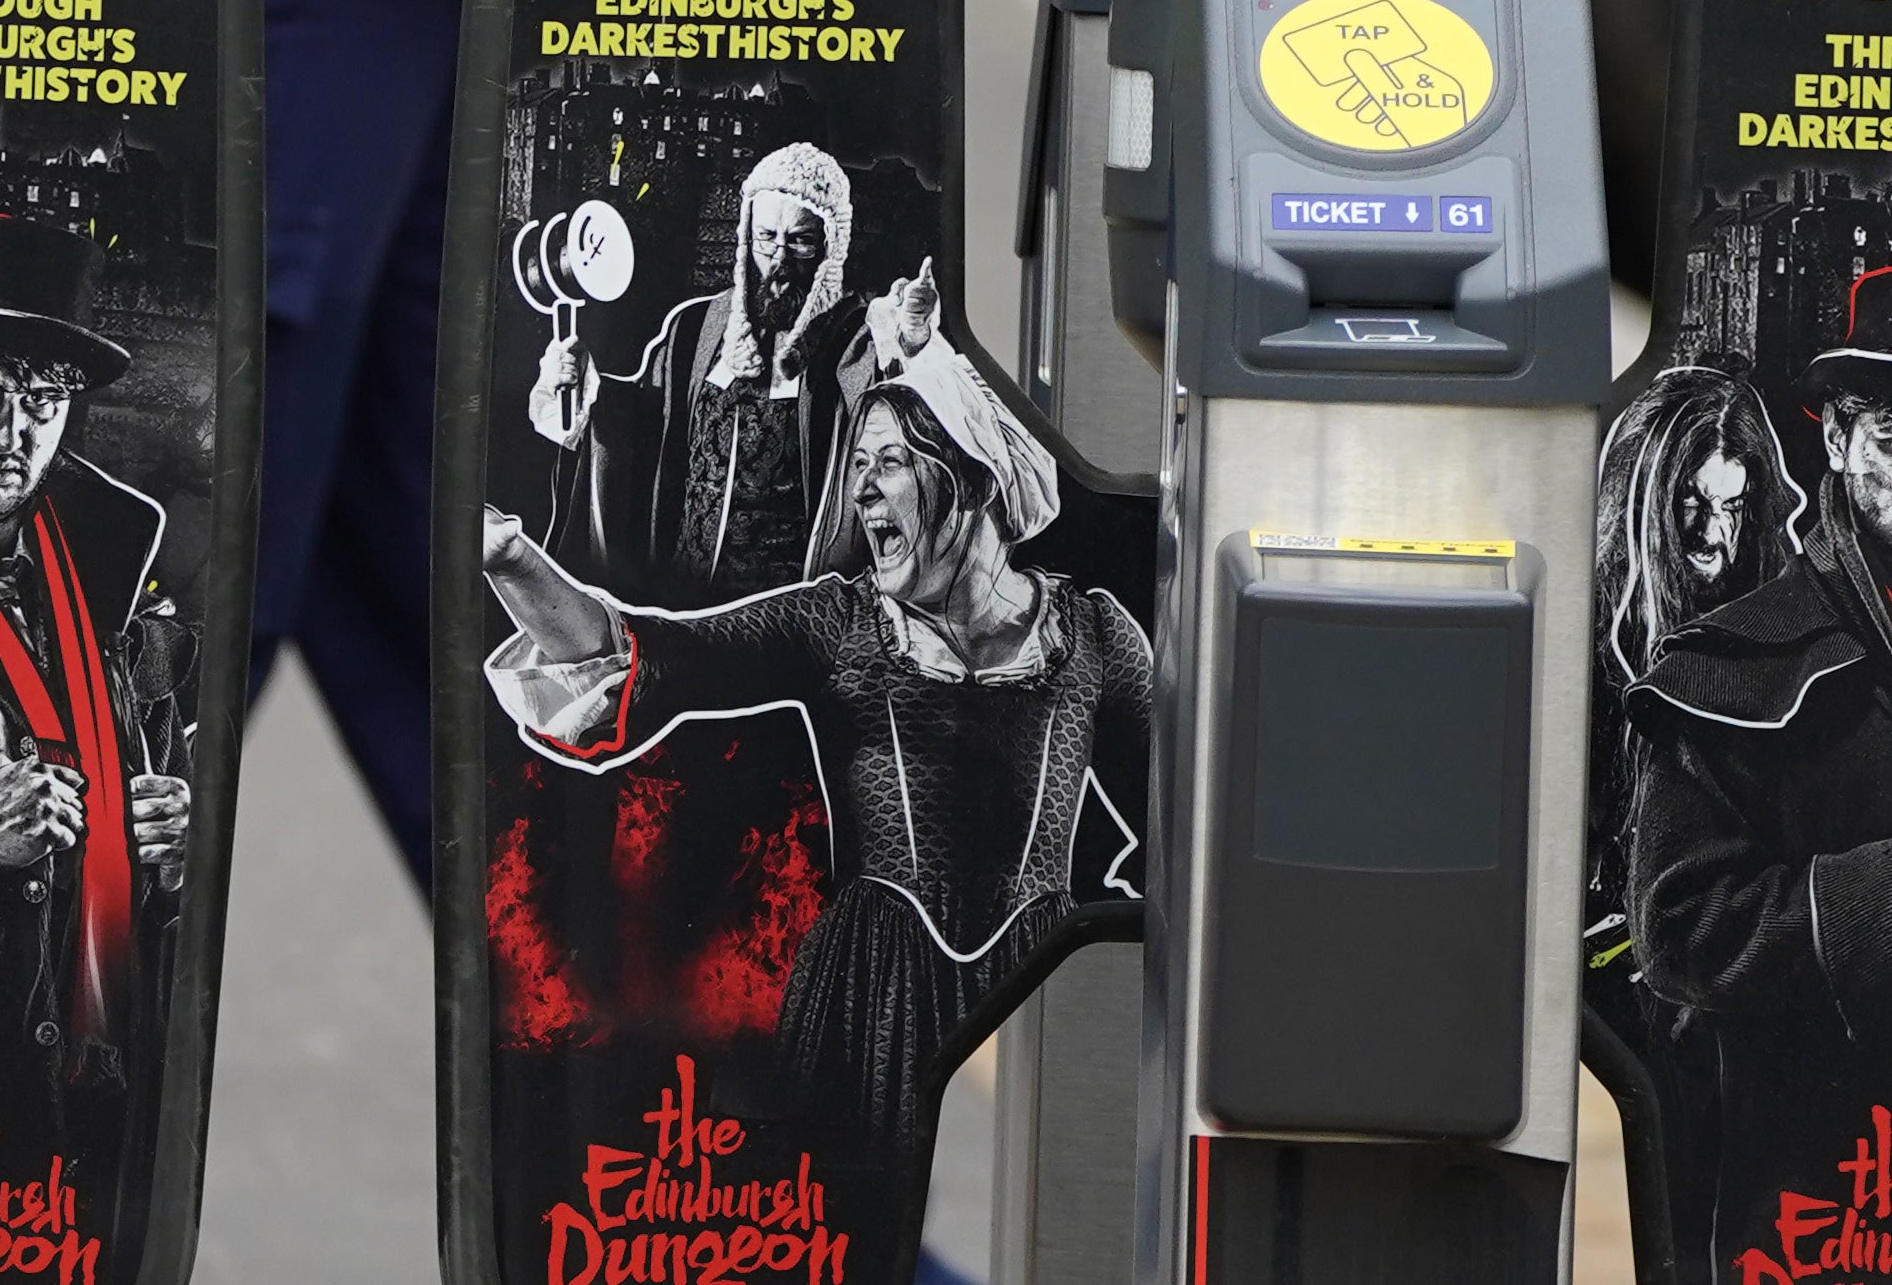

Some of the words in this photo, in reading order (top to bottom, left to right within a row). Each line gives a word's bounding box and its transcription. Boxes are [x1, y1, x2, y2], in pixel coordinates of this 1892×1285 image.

[1335, 23, 1390, 40] TAP
[1415, 73, 1435, 89] &
[1382, 91, 1460, 110] HOLD
[1285, 200, 1386, 225] TICKET
[1448, 203, 1485, 227] 61
[644, 1055, 746, 1167] the
[583, 1145, 824, 1231] Edinburgh
